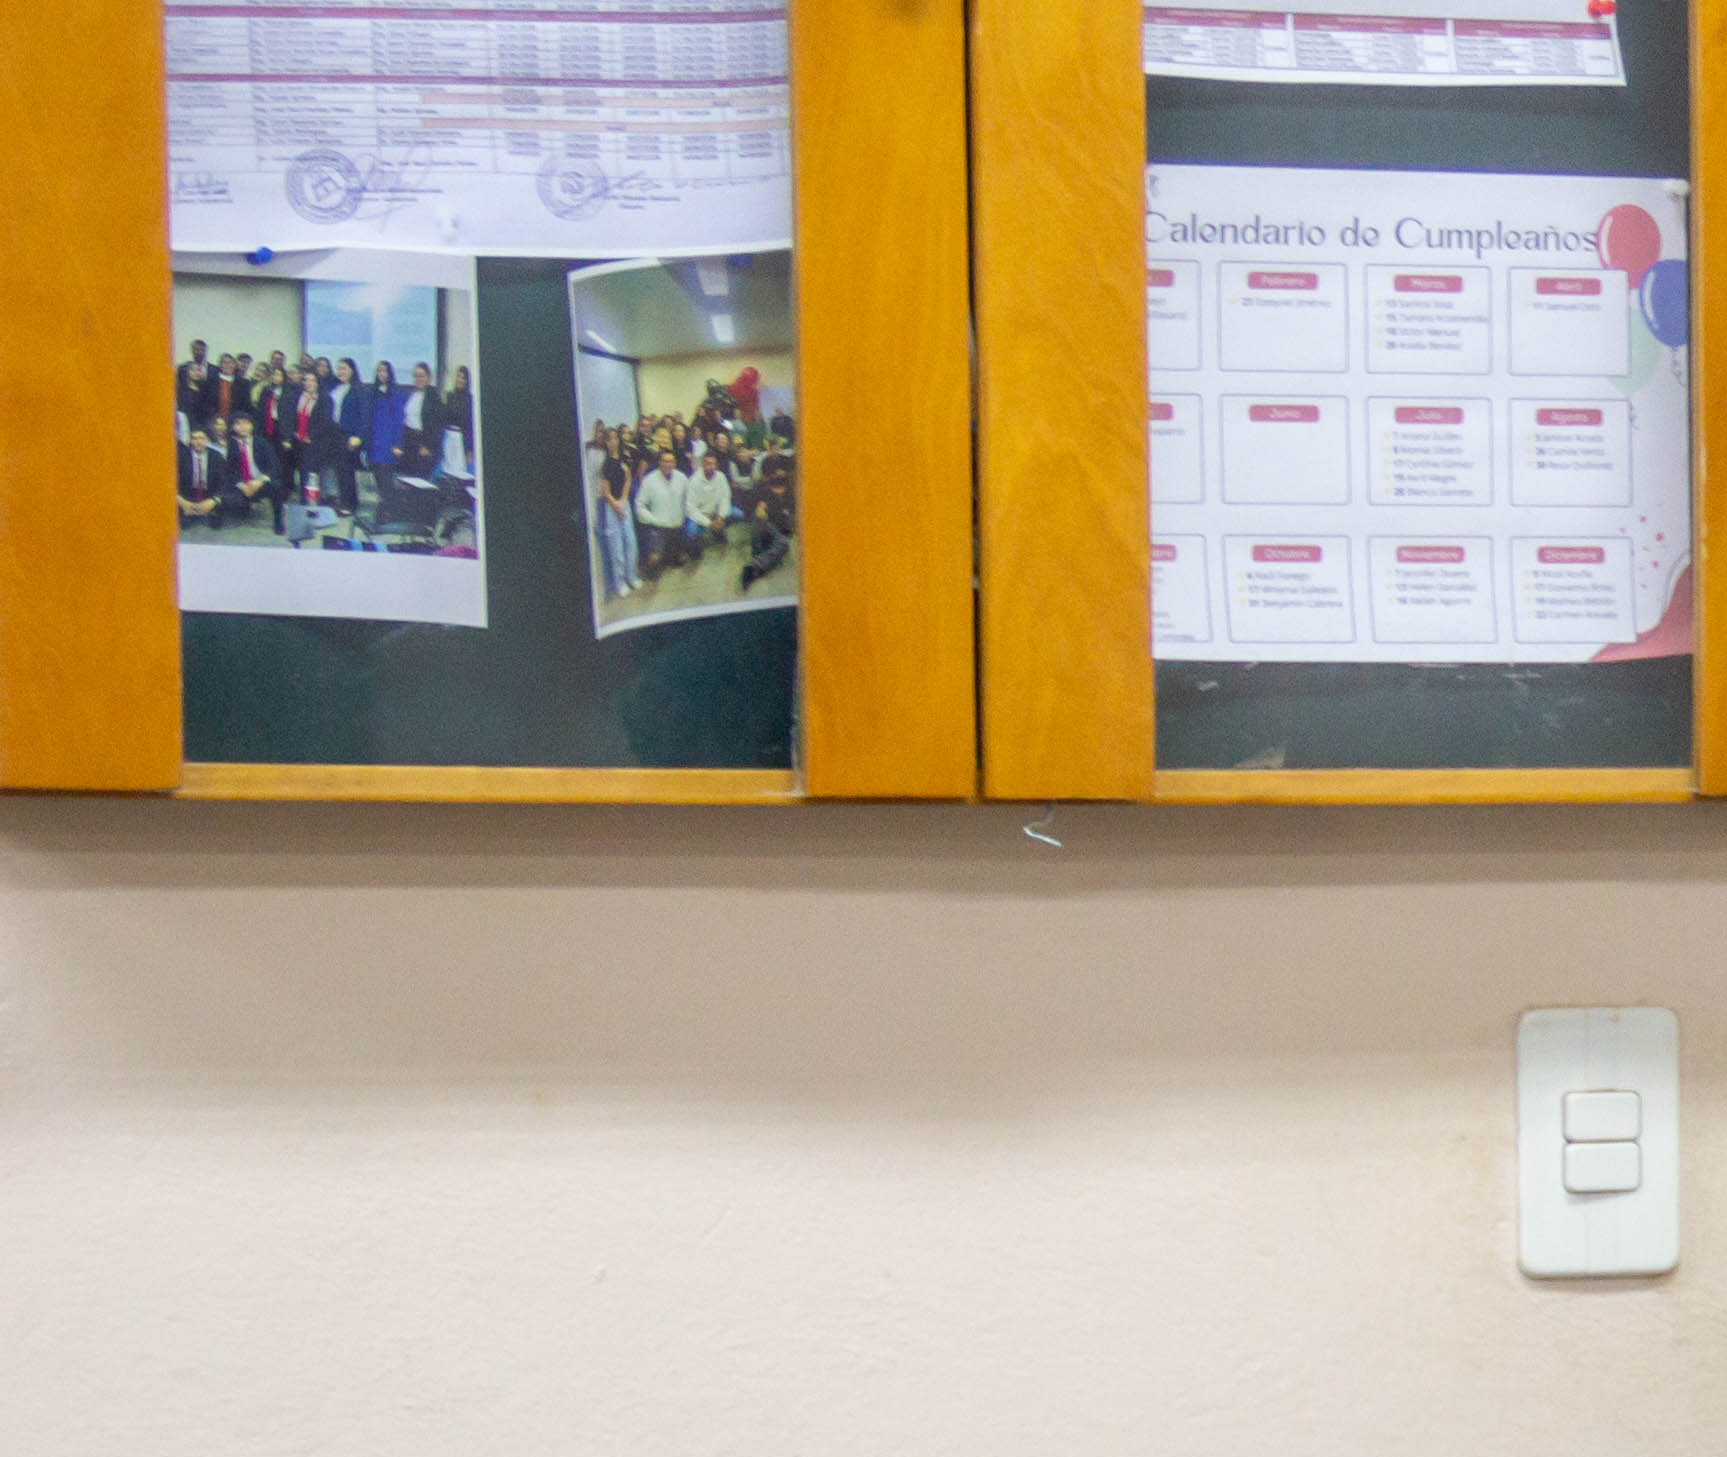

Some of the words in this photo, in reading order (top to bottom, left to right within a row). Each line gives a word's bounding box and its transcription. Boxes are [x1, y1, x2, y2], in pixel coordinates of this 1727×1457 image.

[1145, 211, 1326, 248] Calendario
[1340, 216, 1380, 248] de
[1395, 216, 1598, 260] Cumpleaños
